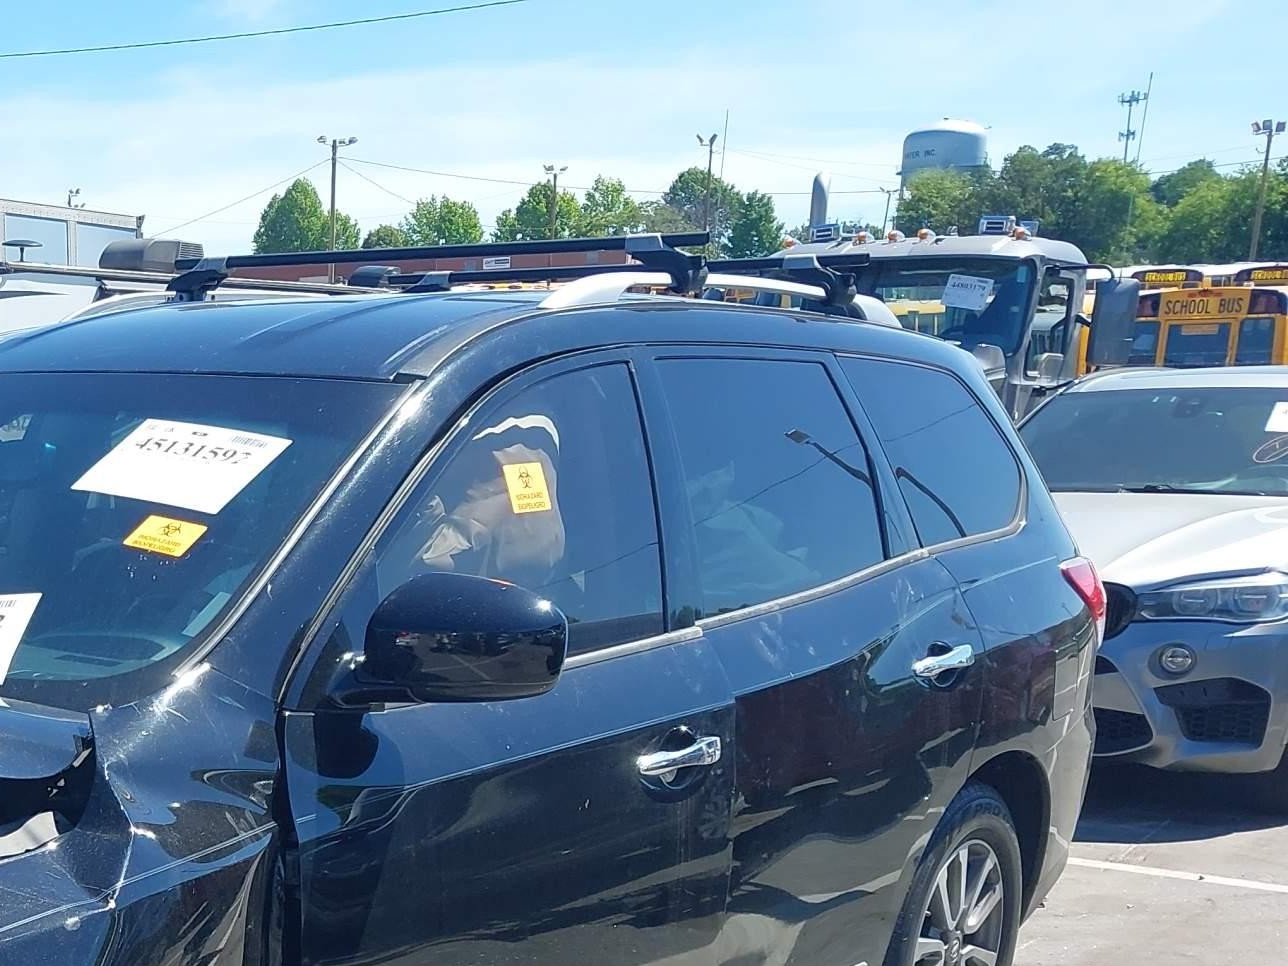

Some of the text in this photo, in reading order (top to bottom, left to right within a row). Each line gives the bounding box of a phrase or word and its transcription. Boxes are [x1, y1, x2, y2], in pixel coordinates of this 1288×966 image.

[1164, 297, 1244, 316] SCHOOL BUS
[135, 436, 253, 465] 45131592
